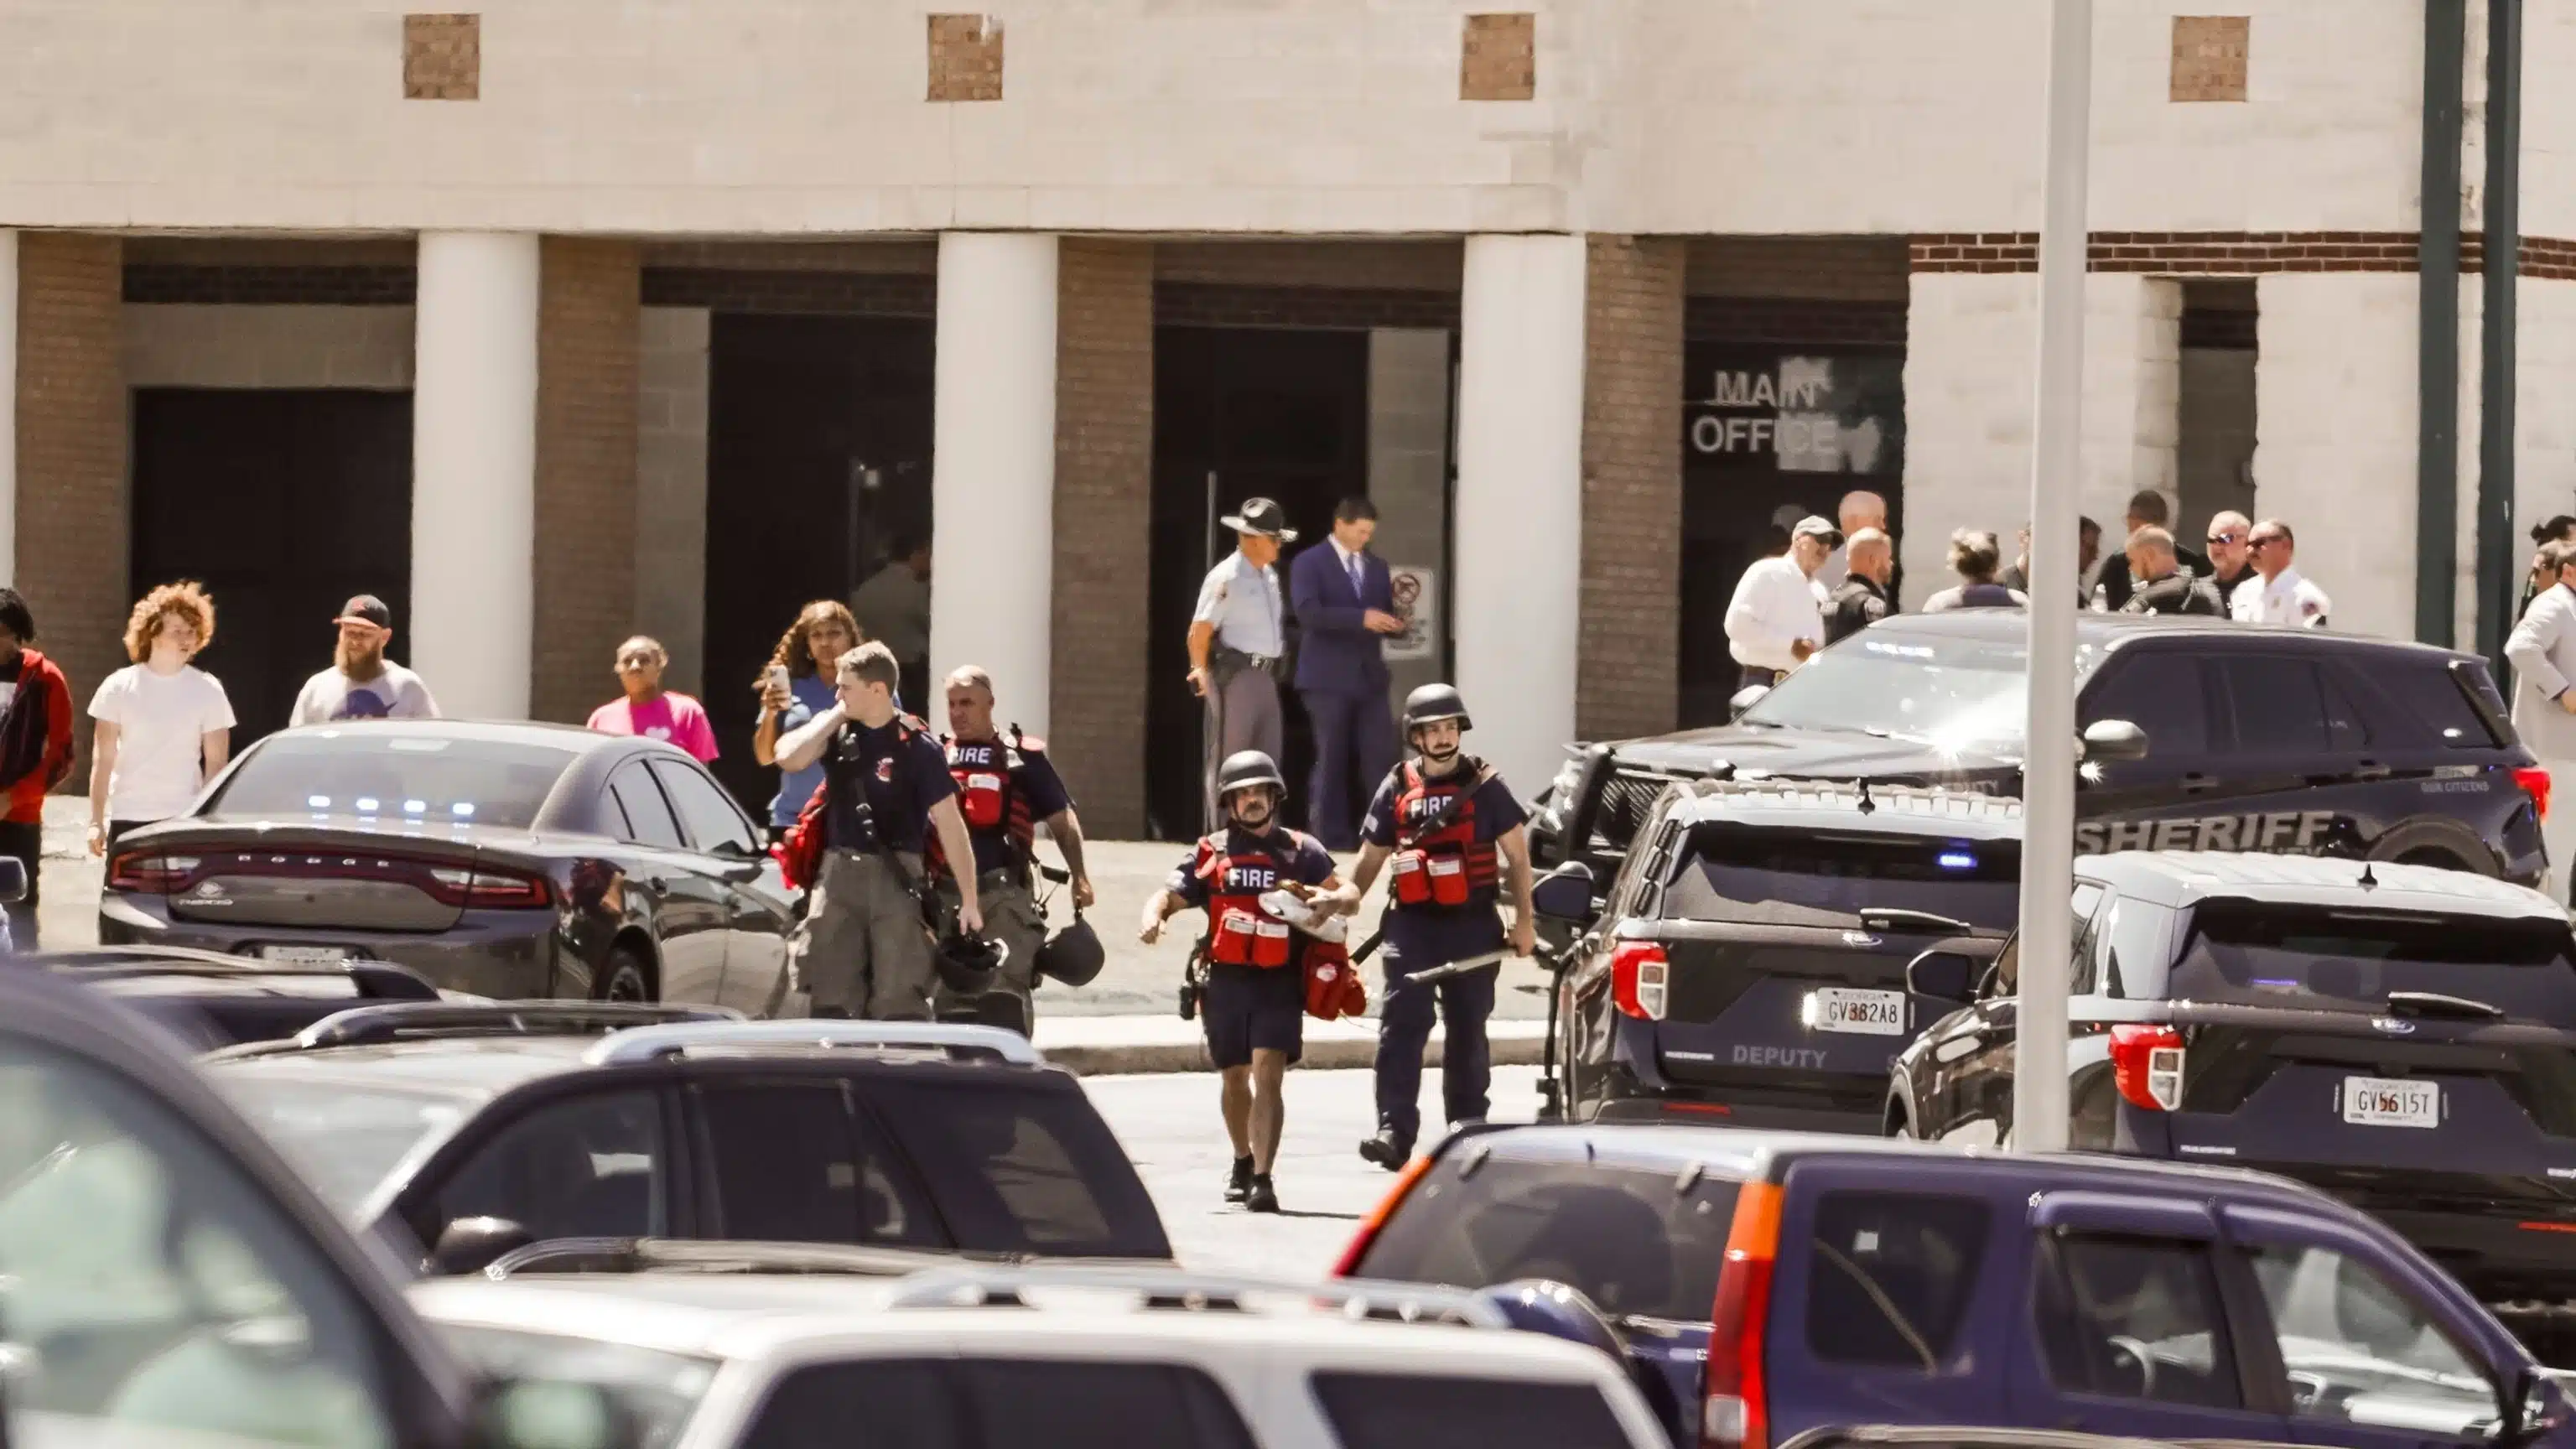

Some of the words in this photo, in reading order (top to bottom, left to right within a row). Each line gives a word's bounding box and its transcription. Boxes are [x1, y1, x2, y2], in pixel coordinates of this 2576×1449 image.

[1715, 370, 1816, 408] MAIN
[1690, 416, 1838, 454] OFFICE
[2076, 811, 2334, 854] SHERIFF
[1228, 867, 1275, 888] FIRE
[1732, 1044, 1827, 1068] DEPUTY
